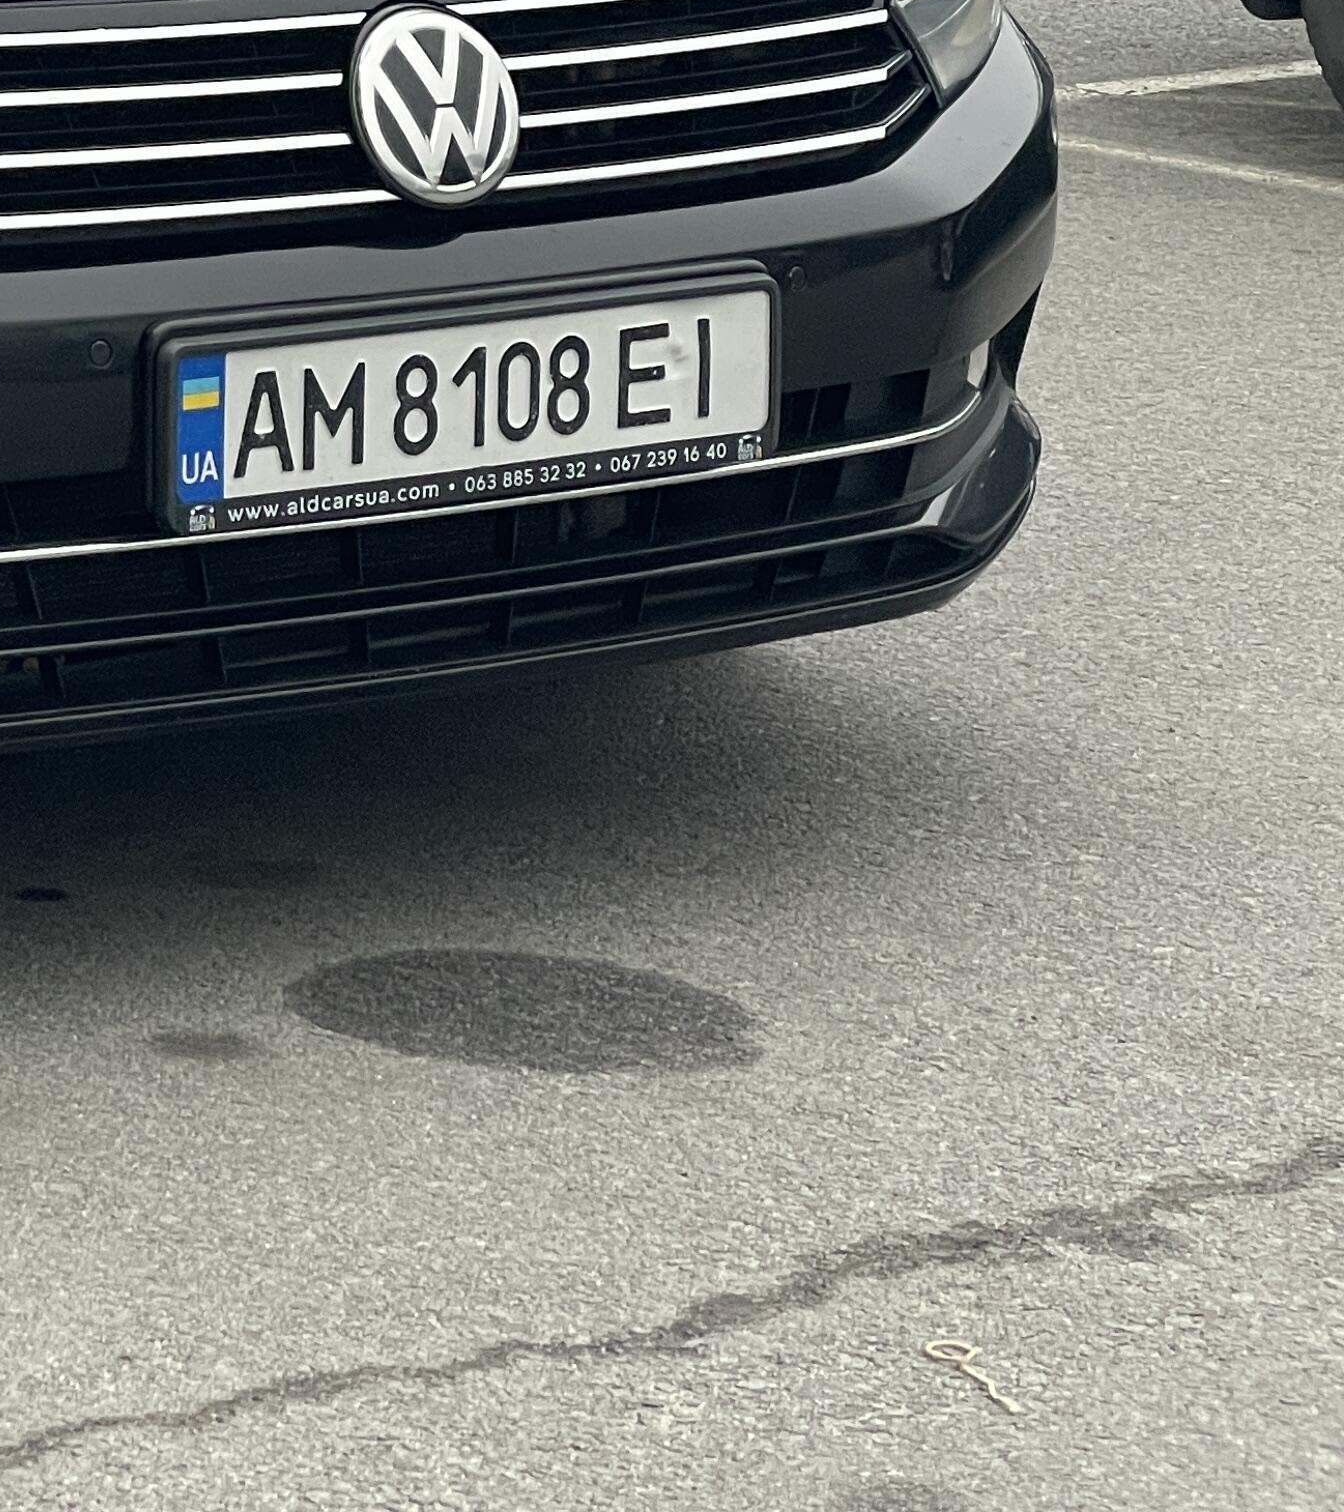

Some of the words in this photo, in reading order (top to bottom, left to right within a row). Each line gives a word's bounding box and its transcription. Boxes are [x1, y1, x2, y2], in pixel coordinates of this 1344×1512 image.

[233, 361, 366, 479] AM
[393, 335, 590, 456] 8108
[181, 450, 219, 484] UA
[227, 482, 440, 523] www.aldcarsua.com
[464, 473, 496, 493] 063
[503, 468, 534, 487] 885
[540, 465, 561, 483] 32
[565, 461, 587, 479] 32
[610, 454, 640, 473] 067
[647, 449, 678, 468] 239
[683, 445, 700, 463] 16
[706, 442, 728, 460] 40
